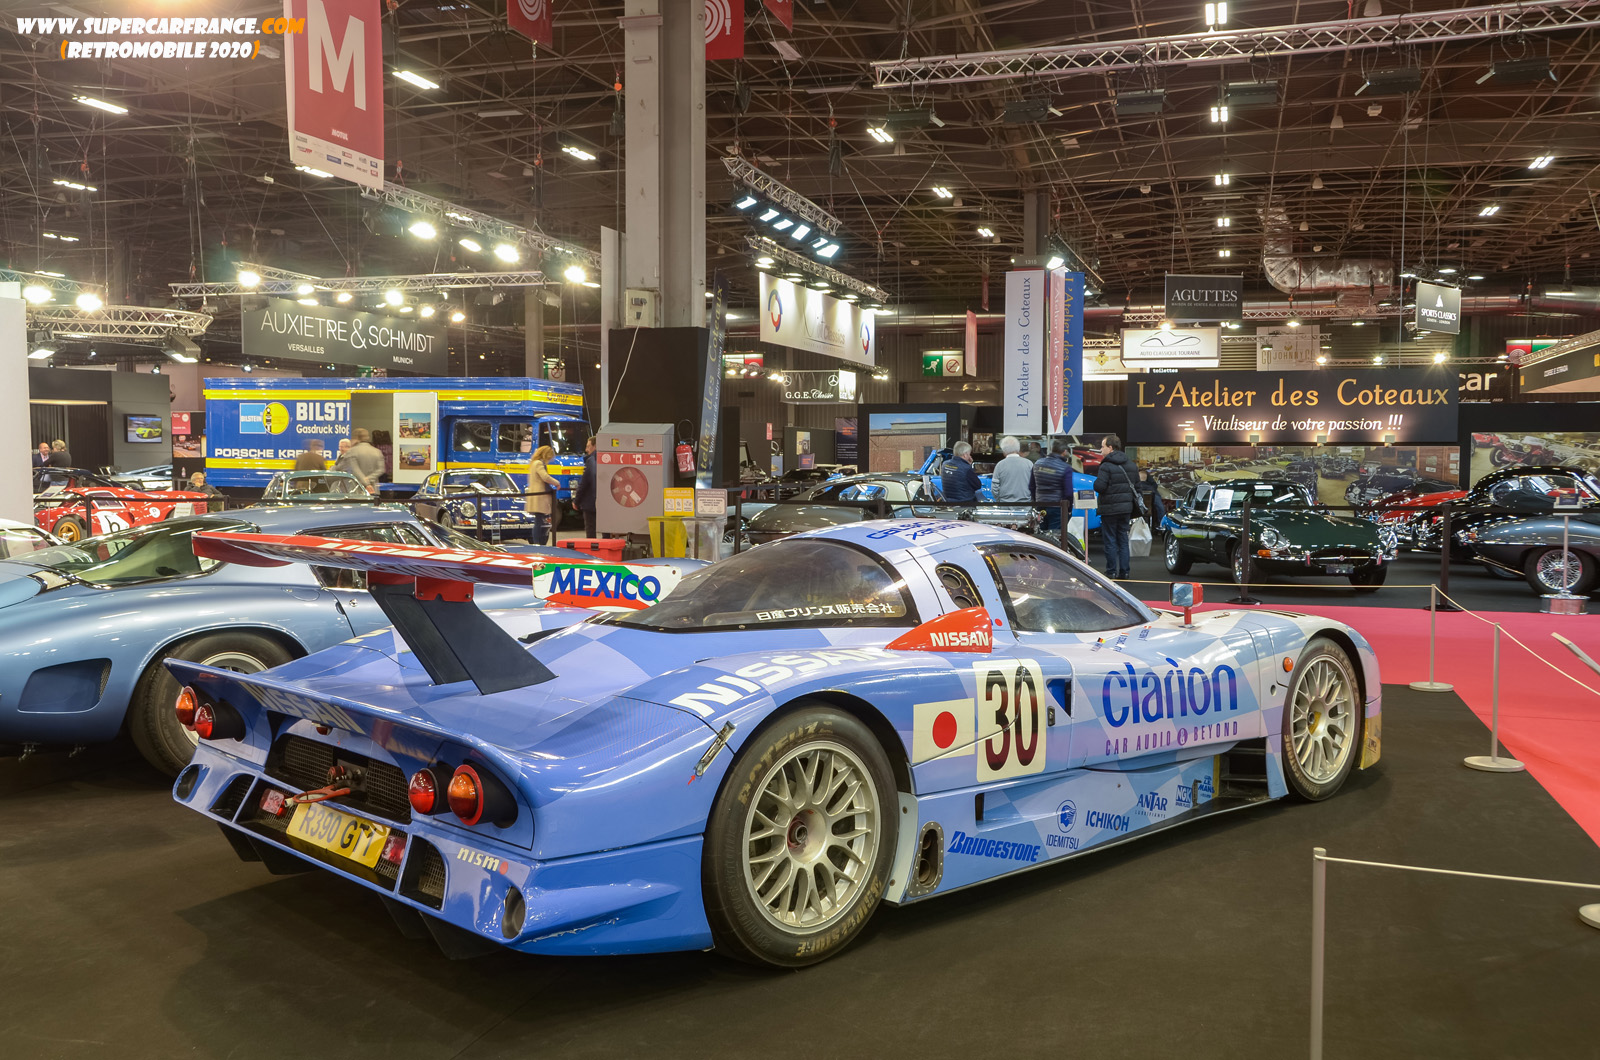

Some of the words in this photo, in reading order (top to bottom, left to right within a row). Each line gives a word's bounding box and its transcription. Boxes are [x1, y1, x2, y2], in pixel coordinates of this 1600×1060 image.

[306, 0, 367, 112] M
[1017, 276, 1031, 328] Coteaux
[1171, 288, 1239, 302] AGUTTES
[708, 284, 723, 362] Coteaux
[1421, 308, 1437, 318] SPORTS
[260, 310, 348, 342] AUXIETRE
[350, 318, 368, 350] &
[368, 325, 435, 354] SCHMIDT
[1021, 333, 1030, 355] des
[287, 343, 325, 355] VERSAILLES
[392, 355, 414, 365] MUNICH
[703, 375, 715, 411] des
[785, 391, 811, 399] G.G.E.
[810, 389, 834, 399] Classic
[1016, 360, 1030, 419] L'Atelier
[1136, 379, 1257, 408] L'Atelier
[1270, 378, 1319, 407] des
[1336, 378, 1449, 407] Coteaux
[296, 424, 333, 434] Gasdruck
[1202, 415, 1269, 431] Vitaliseur
[1271, 415, 1287, 431] de
[1290, 416, 1326, 431] votre
[1327, 416, 1384, 436] passion
[1388, 414, 1404, 431] !!!
[214, 448, 274, 458] PORSCHE
[278, 449, 332, 459] KREER
[549, 566, 661, 601] MEXICO
[930, 631, 990, 647] NISSAN
[668, 648, 902, 718] NISSAN
[239, 681, 367, 735] NISSAN
[985, 665, 1038, 772] 30
[1105, 737, 1128, 756] CAR
[1136, 732, 1171, 750] AUDIO
[1193, 721, 1239, 742] BEYOND
[1136, 791, 1168, 811] ANTAR
[1176, 785, 1192, 803] NGK
[299, 806, 342, 843] R390
[1085, 810, 1130, 832] ICHIKOH
[948, 830, 1041, 862] BRIDGESTONE
[1046, 834, 1080, 850] IDEMITSU
